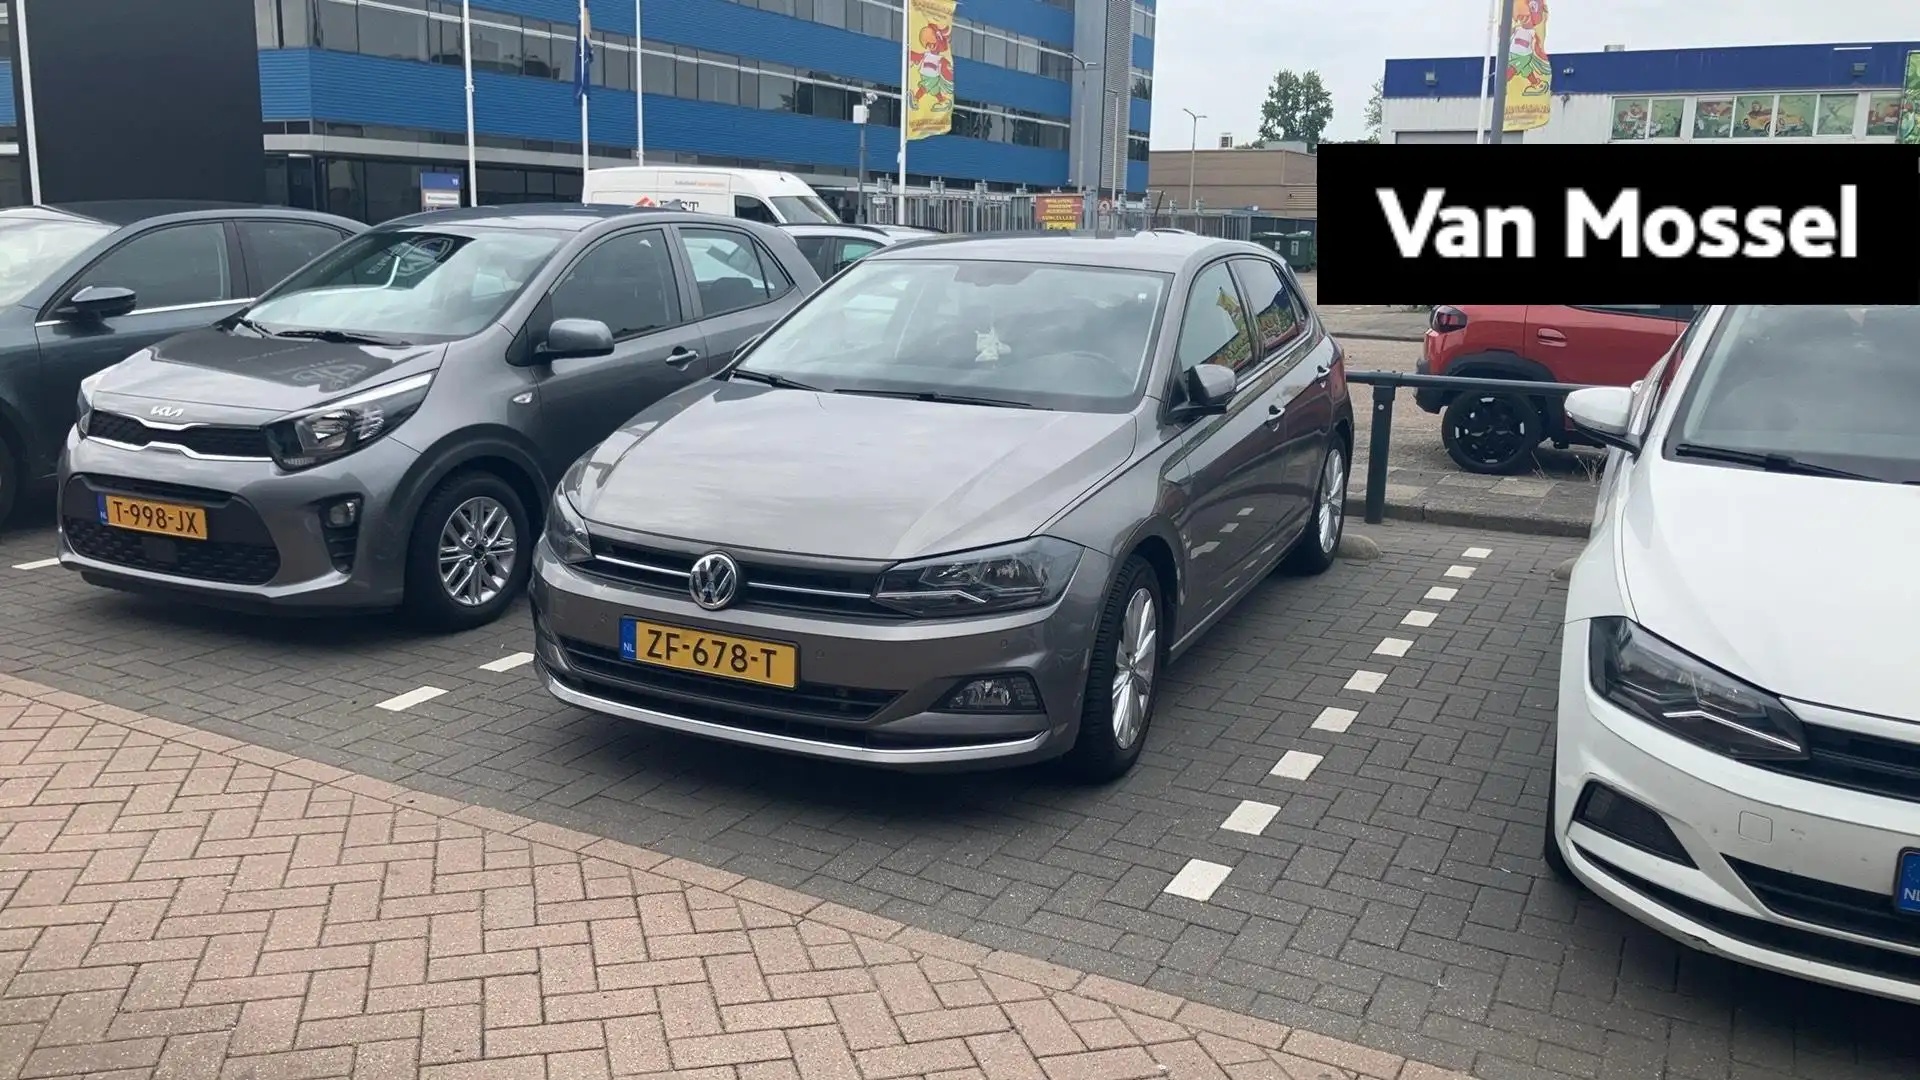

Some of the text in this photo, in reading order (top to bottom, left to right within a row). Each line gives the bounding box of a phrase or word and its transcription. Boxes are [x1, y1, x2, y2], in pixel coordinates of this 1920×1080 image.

[113, 500, 198, 534] T-998-JX
[623, 642, 635, 653] NL
[647, 629, 777, 678] ZF-678-T
